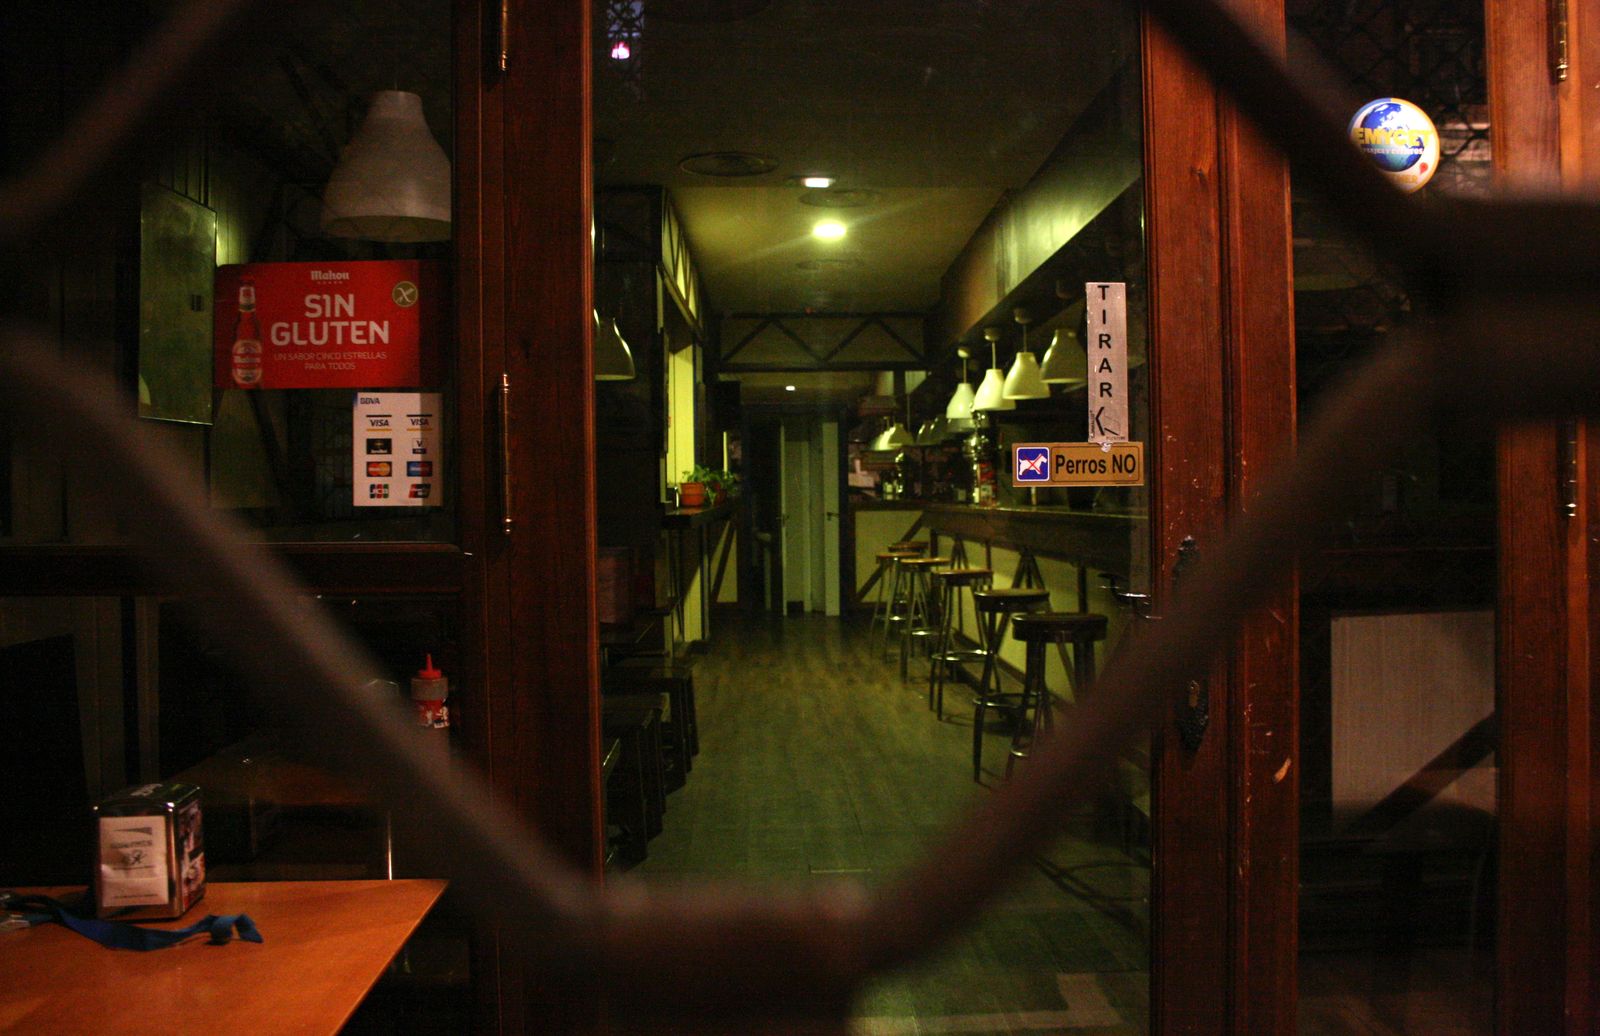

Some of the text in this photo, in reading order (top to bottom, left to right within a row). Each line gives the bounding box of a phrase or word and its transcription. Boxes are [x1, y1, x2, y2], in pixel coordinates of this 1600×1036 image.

[310, 270, 350, 280] Mahou
[304, 293, 355, 318] SIN
[270, 320, 390, 346] GLUTEN
[1097, 285, 1113, 398] TIRAR
[273, 351, 388, 360] UN SABOR CINCO ESTRELLAS
[304, 362, 356, 370] PARA TODOS
[370, 419, 390, 427] VISA
[410, 418, 429, 426] VISA
[1055, 454, 1136, 475] Perros NO
